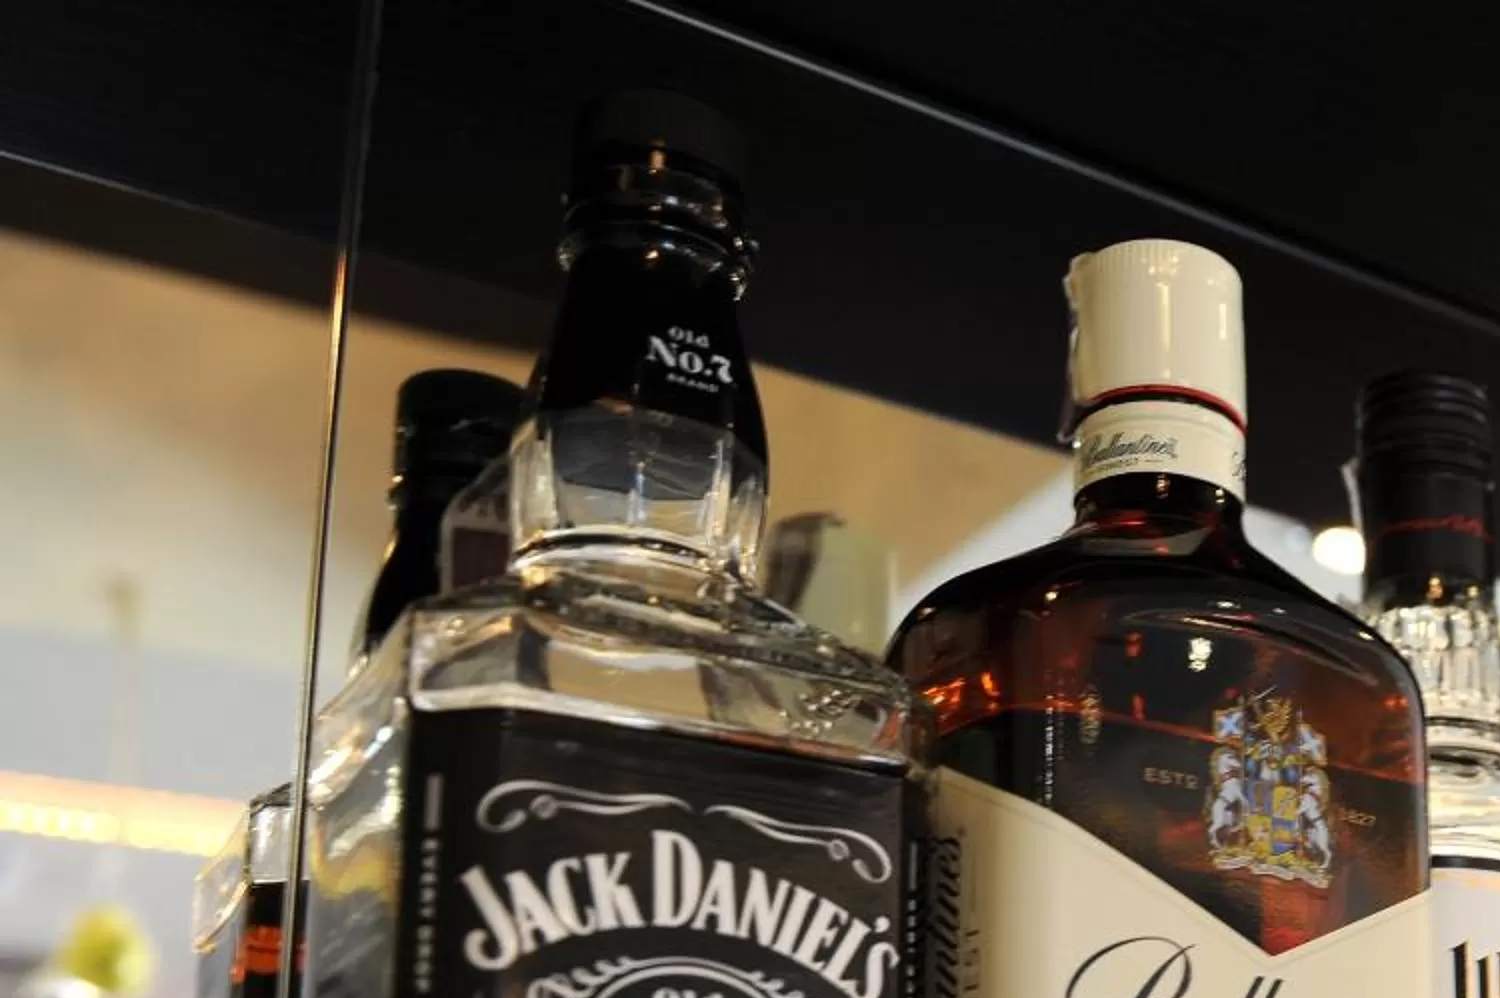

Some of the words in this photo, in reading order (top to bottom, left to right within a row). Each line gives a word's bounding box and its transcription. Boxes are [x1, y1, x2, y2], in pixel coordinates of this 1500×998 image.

[644, 335, 734, 384] No.7
[667, 325, 710, 349] Old
[460, 852, 646, 972] JACK
